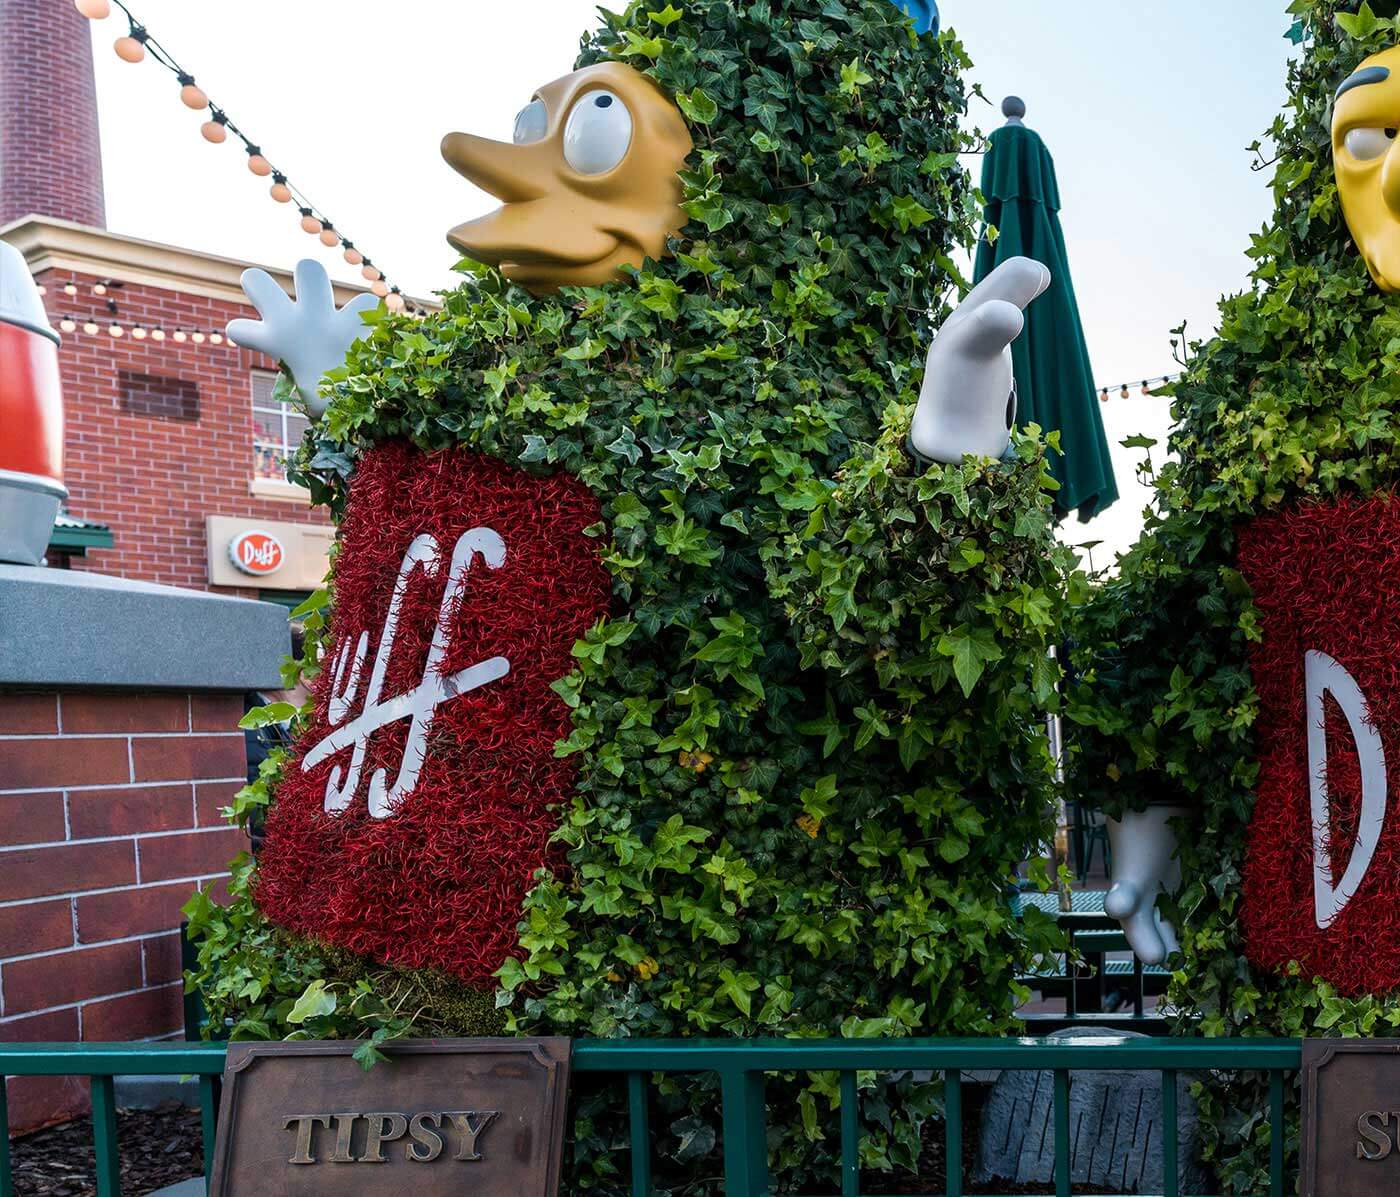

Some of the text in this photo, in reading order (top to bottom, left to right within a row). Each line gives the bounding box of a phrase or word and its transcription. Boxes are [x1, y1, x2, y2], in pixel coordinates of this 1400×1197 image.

[243, 540, 280, 566] Duff
[302, 527, 511, 818] uff
[282, 1111, 502, 1165] TIPSY
